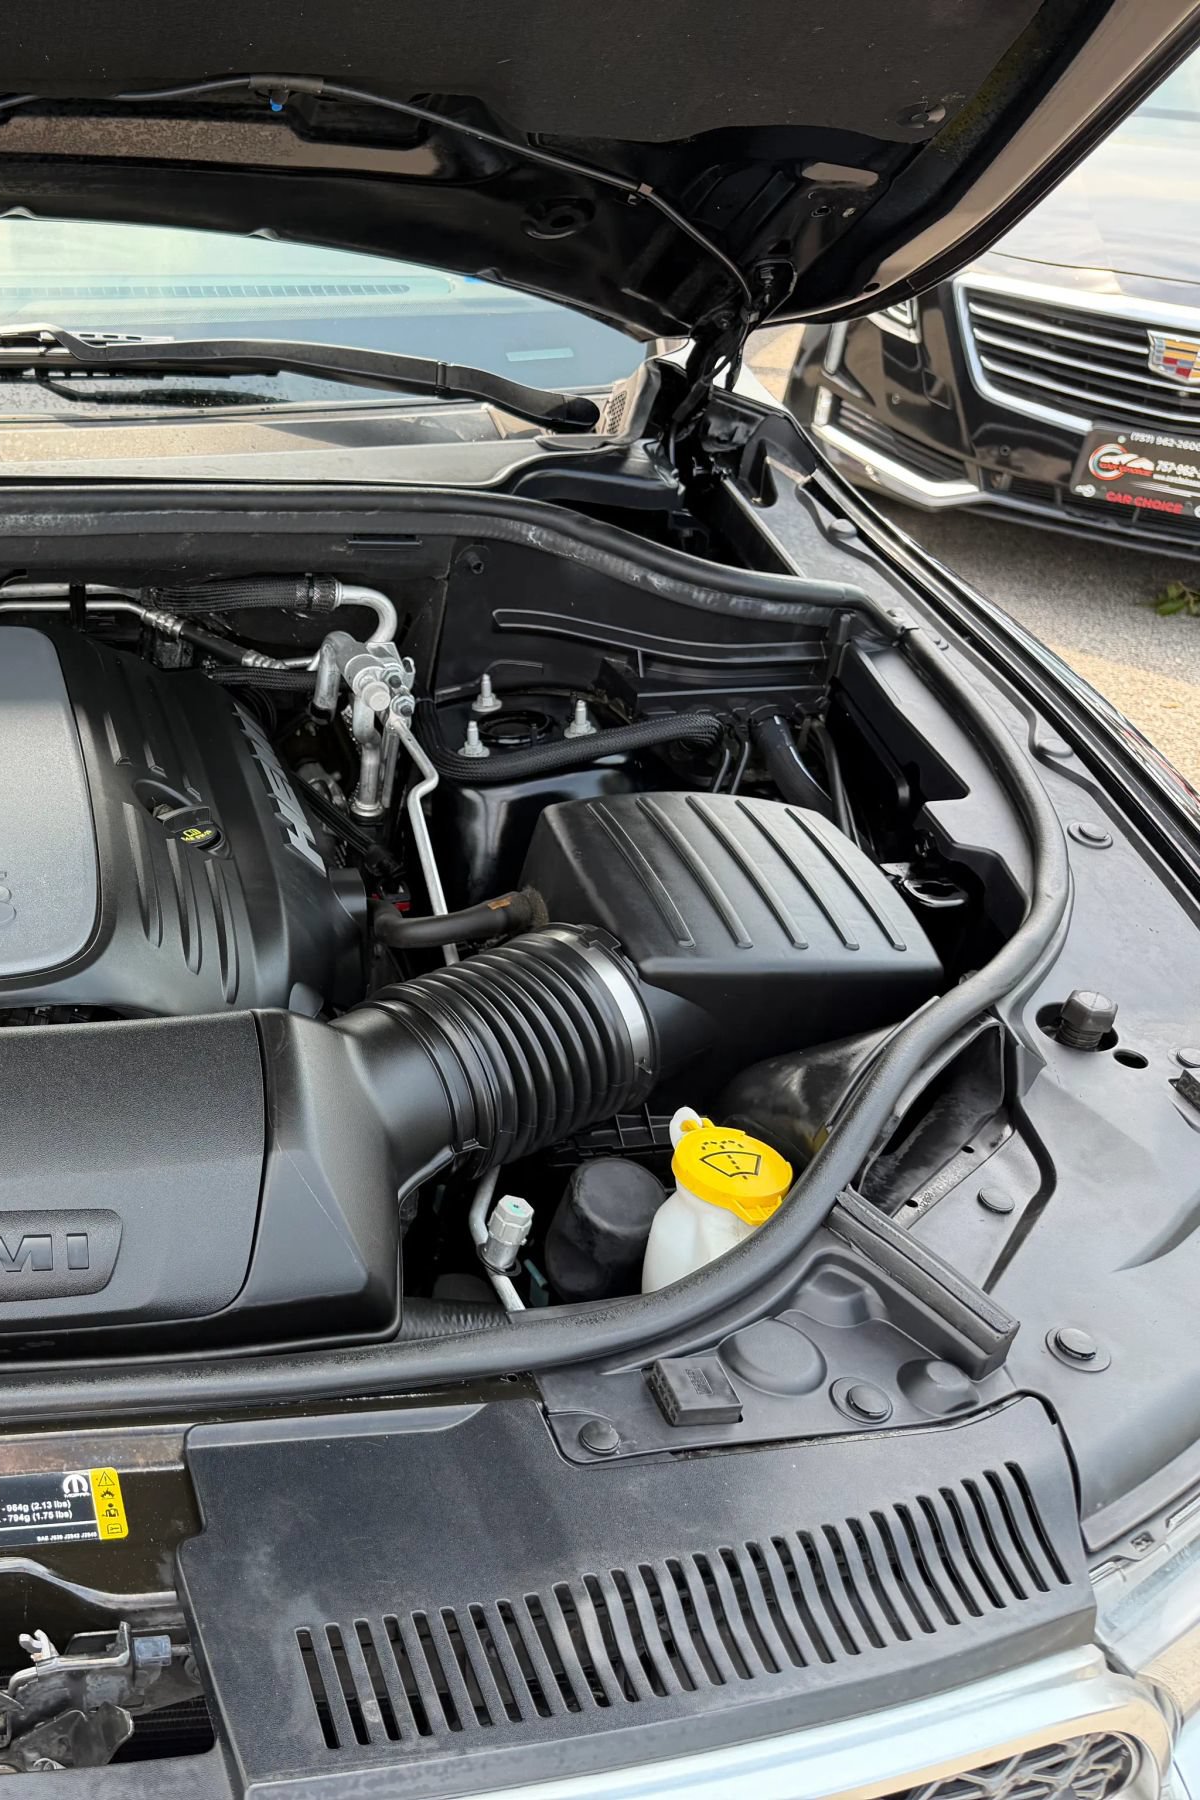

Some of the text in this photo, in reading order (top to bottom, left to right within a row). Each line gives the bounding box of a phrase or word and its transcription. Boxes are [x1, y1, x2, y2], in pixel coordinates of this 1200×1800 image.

[1106, 491, 1184, 515] CAR CHOICE
[31, 1501, 54, 1511] (2.13
[54, 1500, 71, 1509] lbs)
[55, 1509, 73, 1519] lbs)
